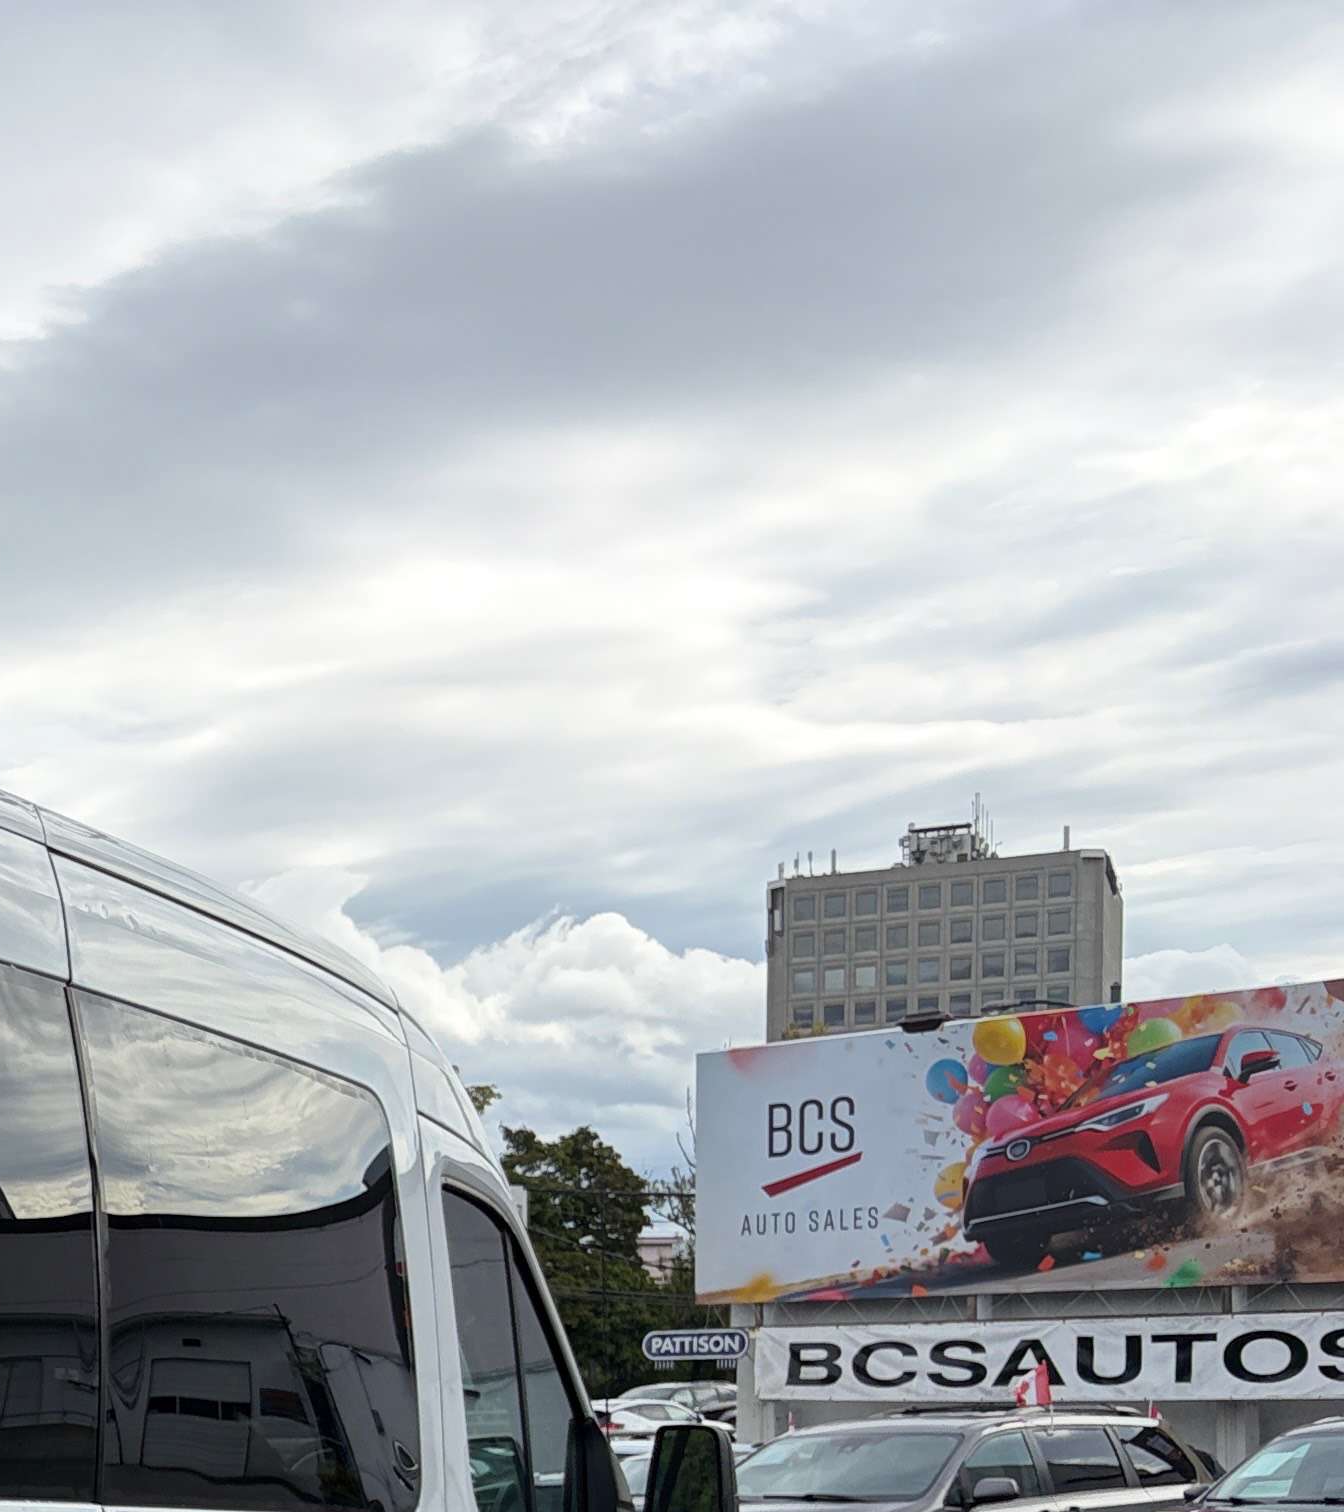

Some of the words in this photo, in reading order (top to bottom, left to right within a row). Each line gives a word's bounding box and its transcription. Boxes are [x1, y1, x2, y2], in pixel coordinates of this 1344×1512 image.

[767, 1096, 856, 1159] BCS
[740, 1213, 796, 1237] AUTO
[808, 1205, 879, 1233] SALES
[651, 1332, 740, 1357] PATTISON
